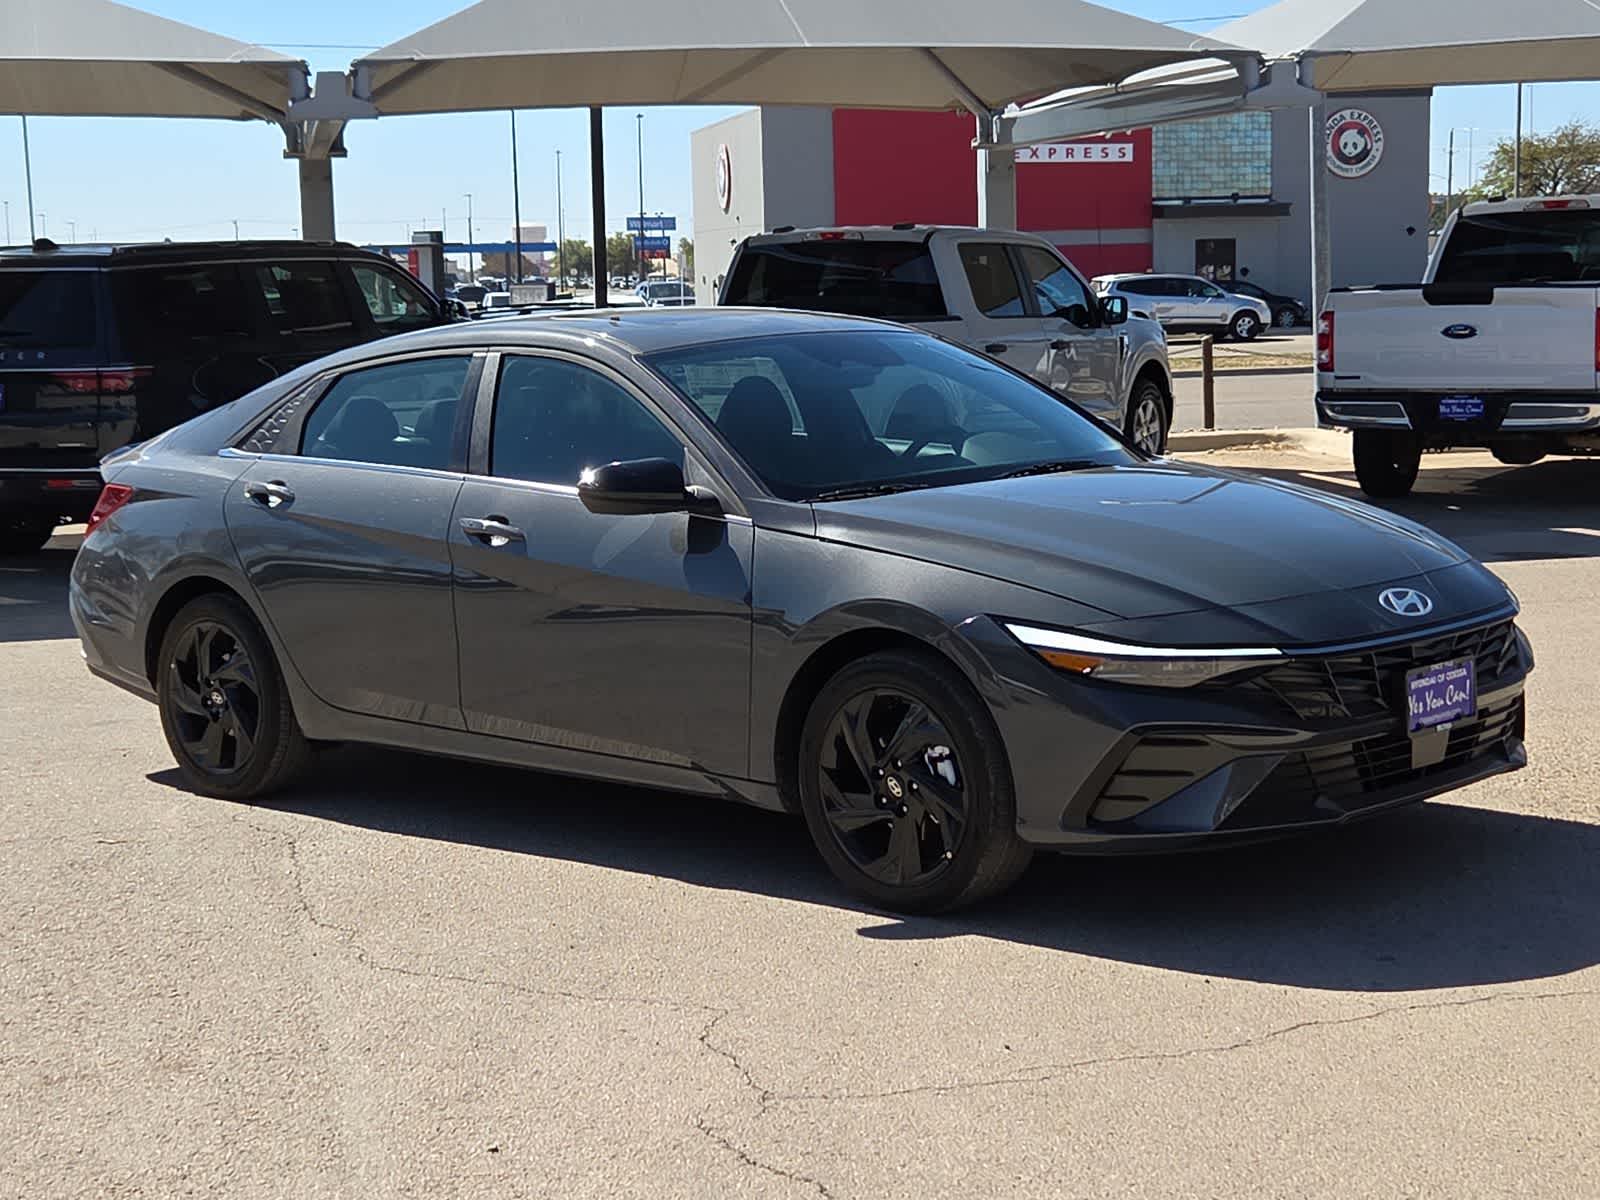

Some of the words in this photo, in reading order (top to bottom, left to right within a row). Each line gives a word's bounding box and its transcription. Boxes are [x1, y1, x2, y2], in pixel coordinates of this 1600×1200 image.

[1350, 111, 1382, 143] EXPRESS
[1014, 147, 1127, 159] EXPRESS
[629, 220, 664, 229] Wamart
[1408, 694, 1423, 716] Yes
[1425, 689, 1445, 712] You
[1446, 679, 1469, 705] Can!
